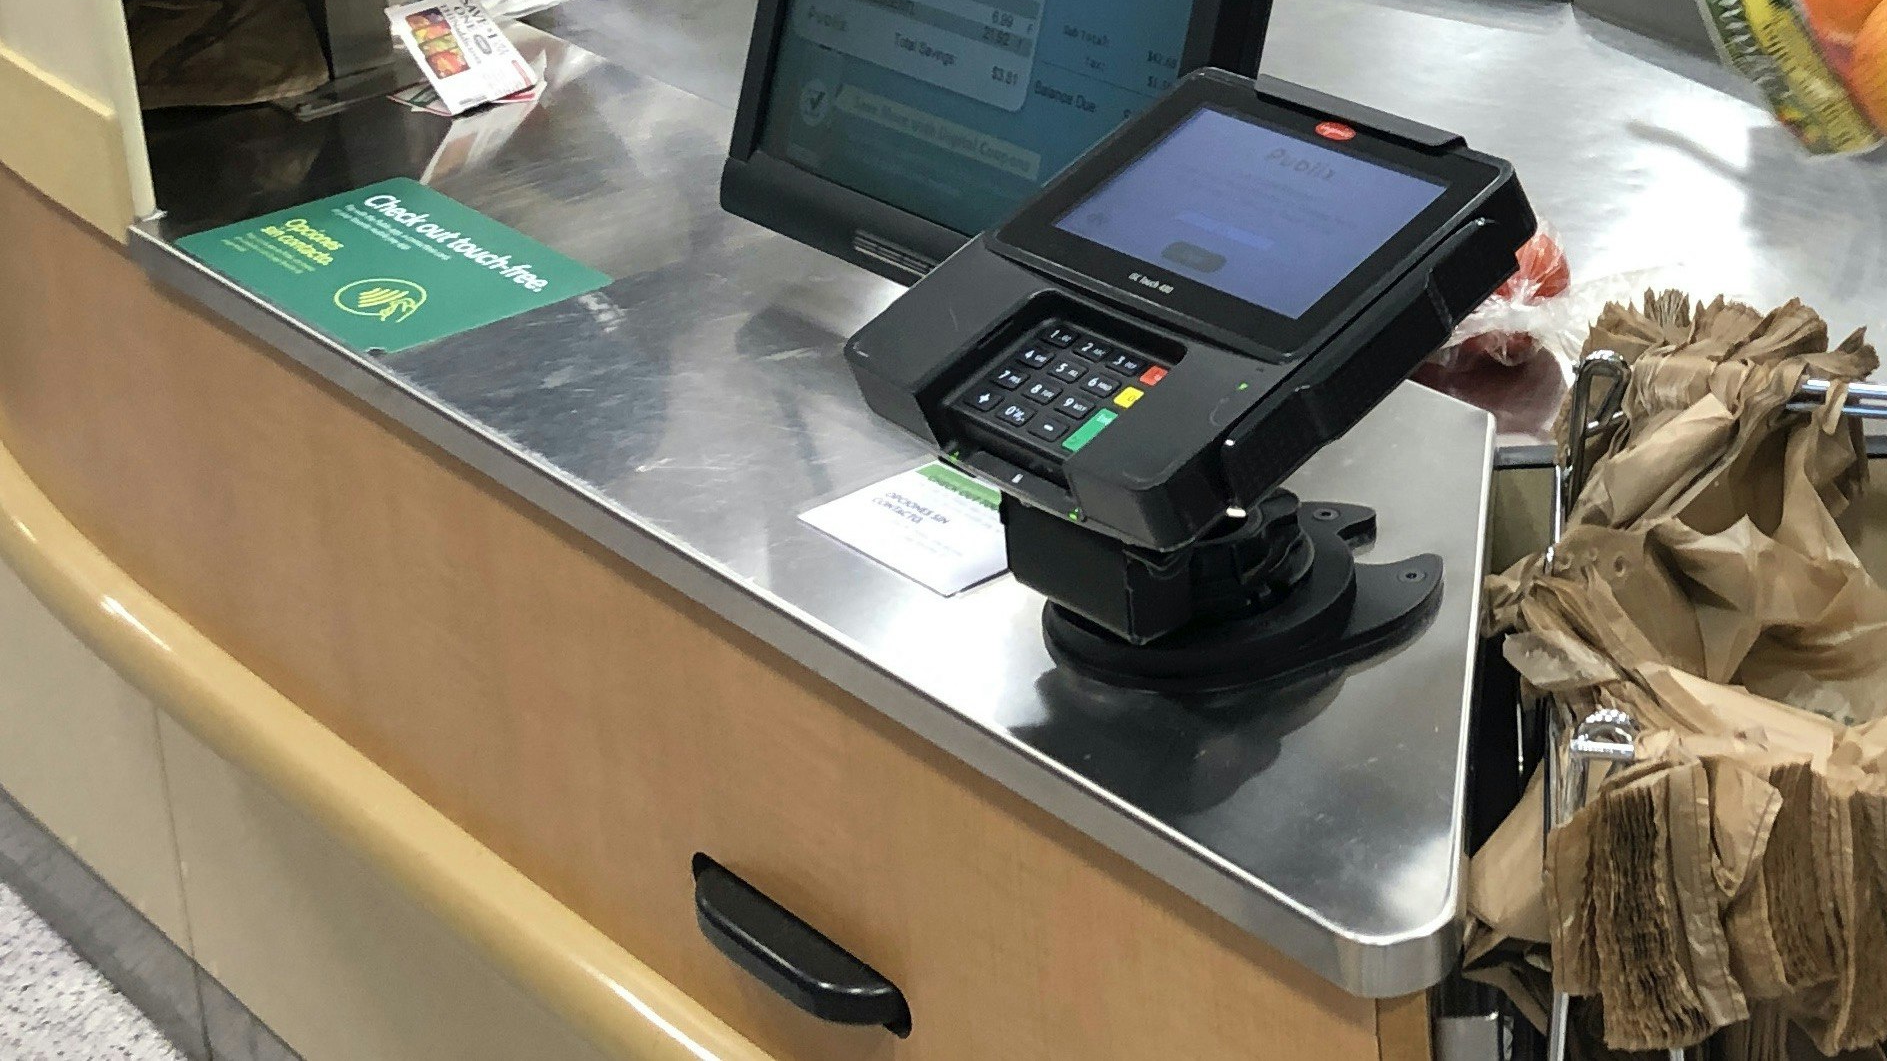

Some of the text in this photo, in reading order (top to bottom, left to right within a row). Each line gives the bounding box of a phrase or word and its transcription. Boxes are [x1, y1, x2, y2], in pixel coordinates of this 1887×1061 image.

[1033, 79, 1097, 113] Balance Due
[364, 193, 431, 228] Check
[416, 219, 463, 245] out
[452, 235, 552, 294] touch-free.
[1081, 342, 1094, 352] 2
[1112, 355, 1126, 365] 3
[1055, 362, 1068, 373] 5
[998, 369, 1011, 380] 7
[1087, 376, 1100, 387] 6
[1030, 383, 1043, 394] 8
[1062, 397, 1075, 408] 9
